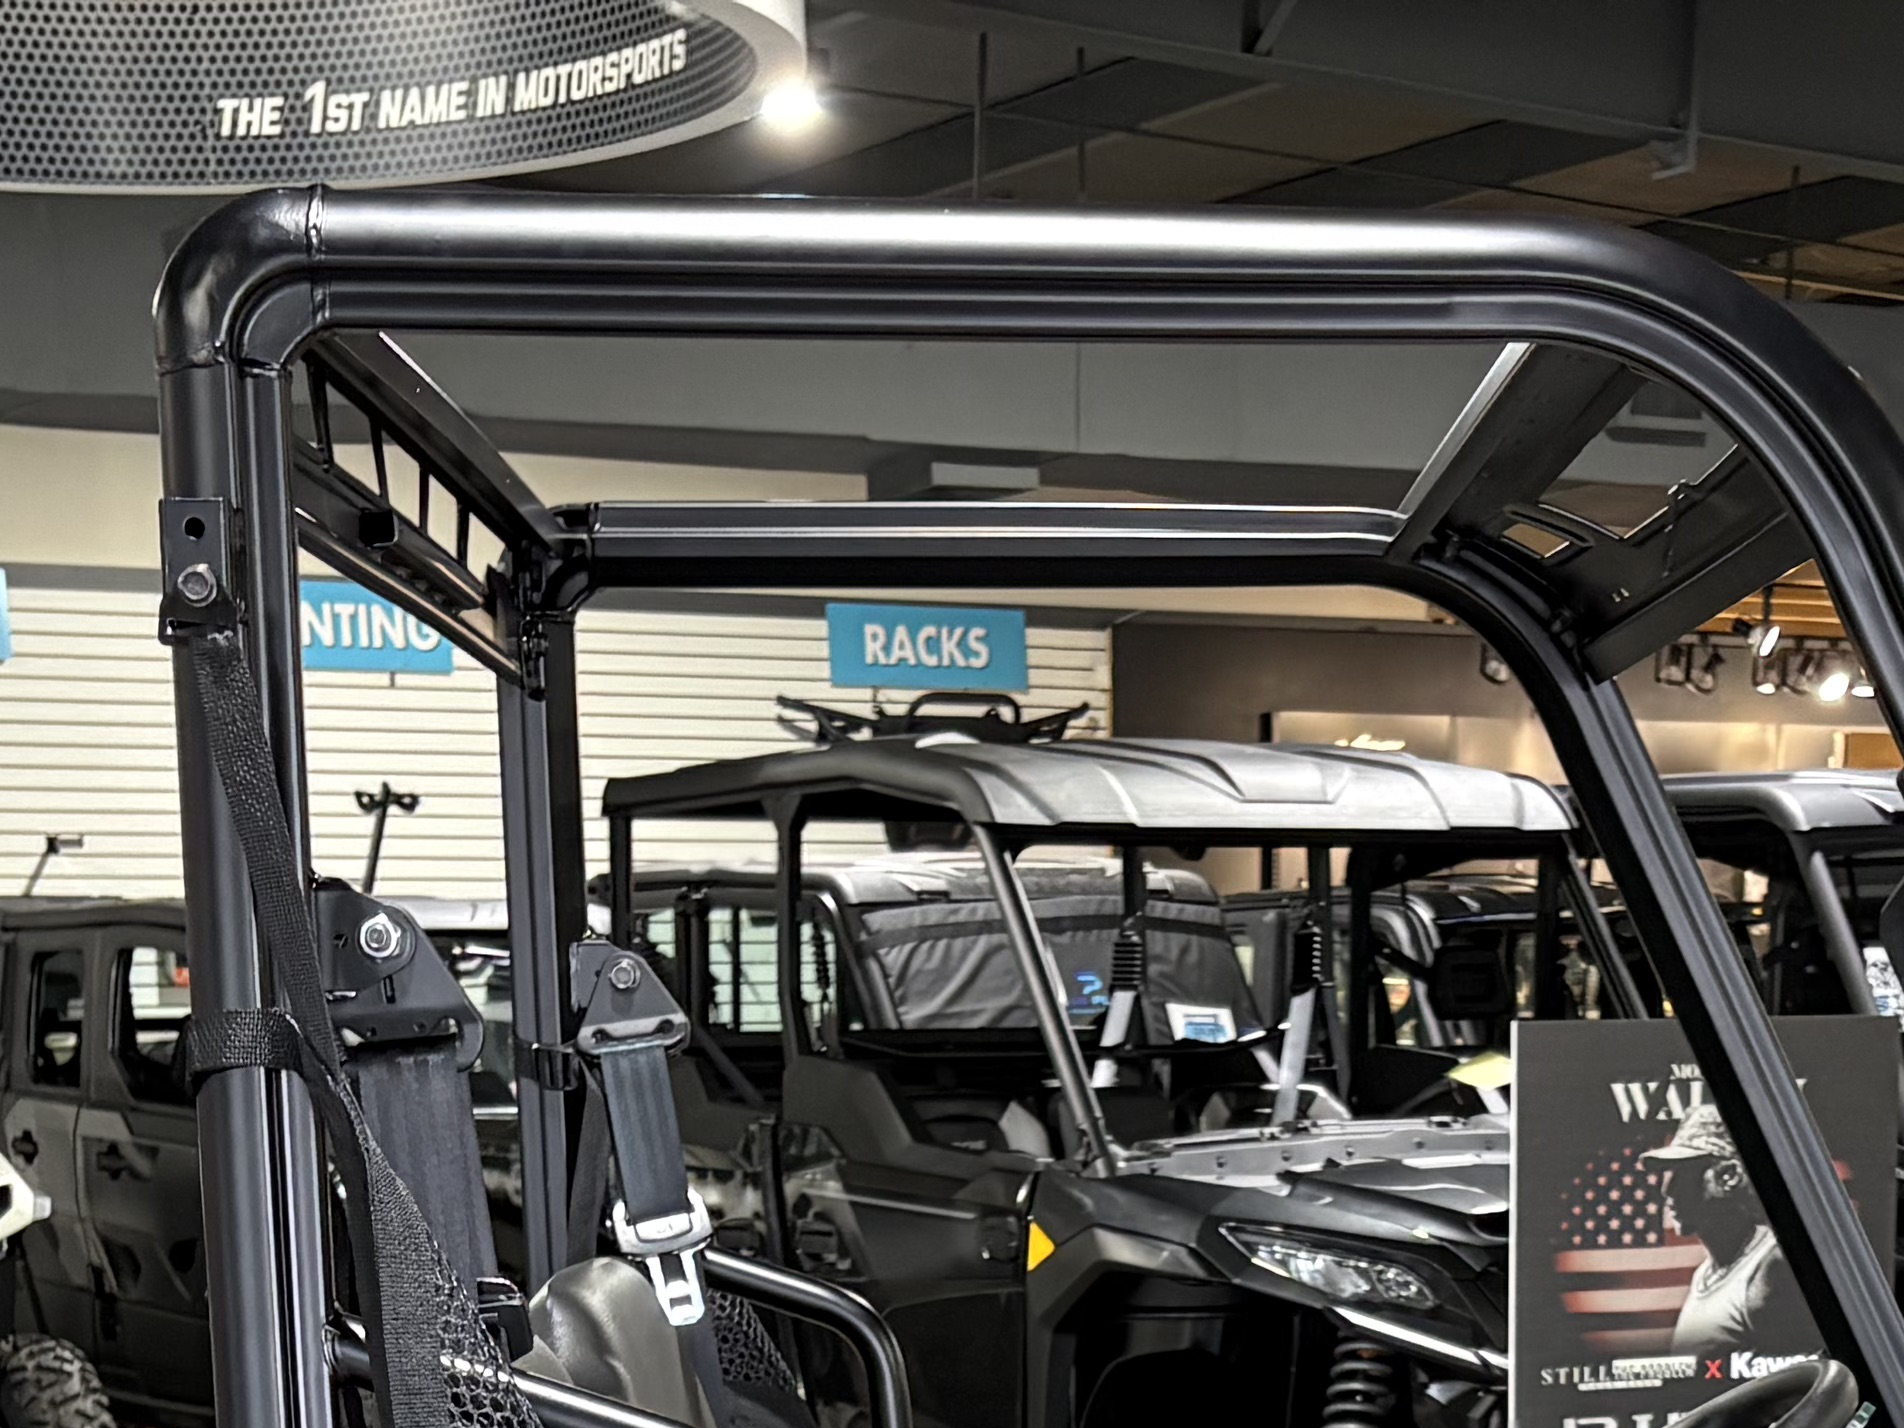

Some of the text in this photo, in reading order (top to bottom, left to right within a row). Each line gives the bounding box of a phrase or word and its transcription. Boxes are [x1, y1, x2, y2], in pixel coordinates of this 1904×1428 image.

[216, 27, 689, 138] THE 1ST NAME IN MOTORSPORTS
[300, 600, 441, 652] NTING
[863, 623, 990, 669] RACKS
[1540, 1364, 1610, 1386] STILL
